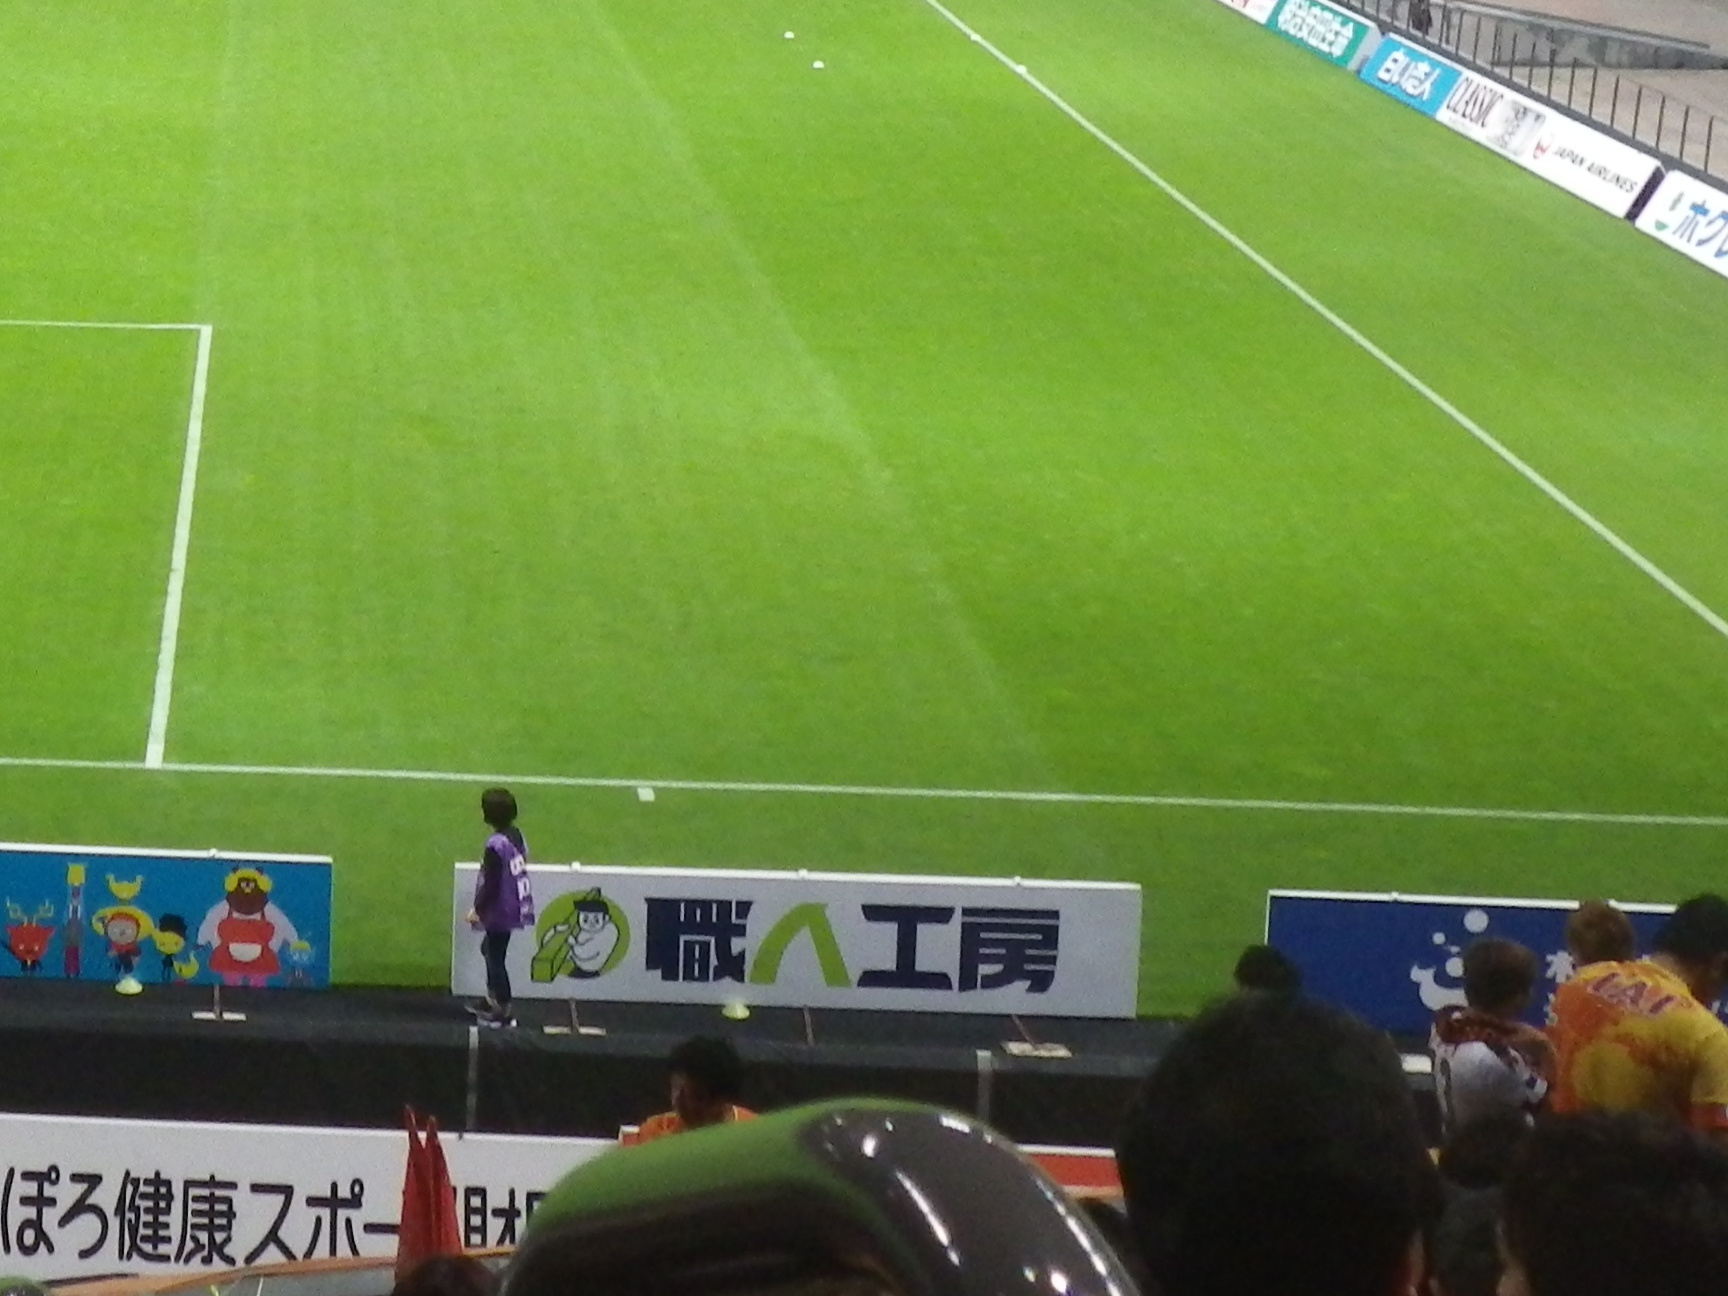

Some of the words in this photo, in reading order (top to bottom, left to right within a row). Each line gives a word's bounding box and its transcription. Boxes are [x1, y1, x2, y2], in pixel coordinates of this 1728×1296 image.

[1552, 143, 1588, 170] JAPAN
[1587, 153, 1639, 195] AIRLINES
[642, 895, 1062, 995] 職人工房
